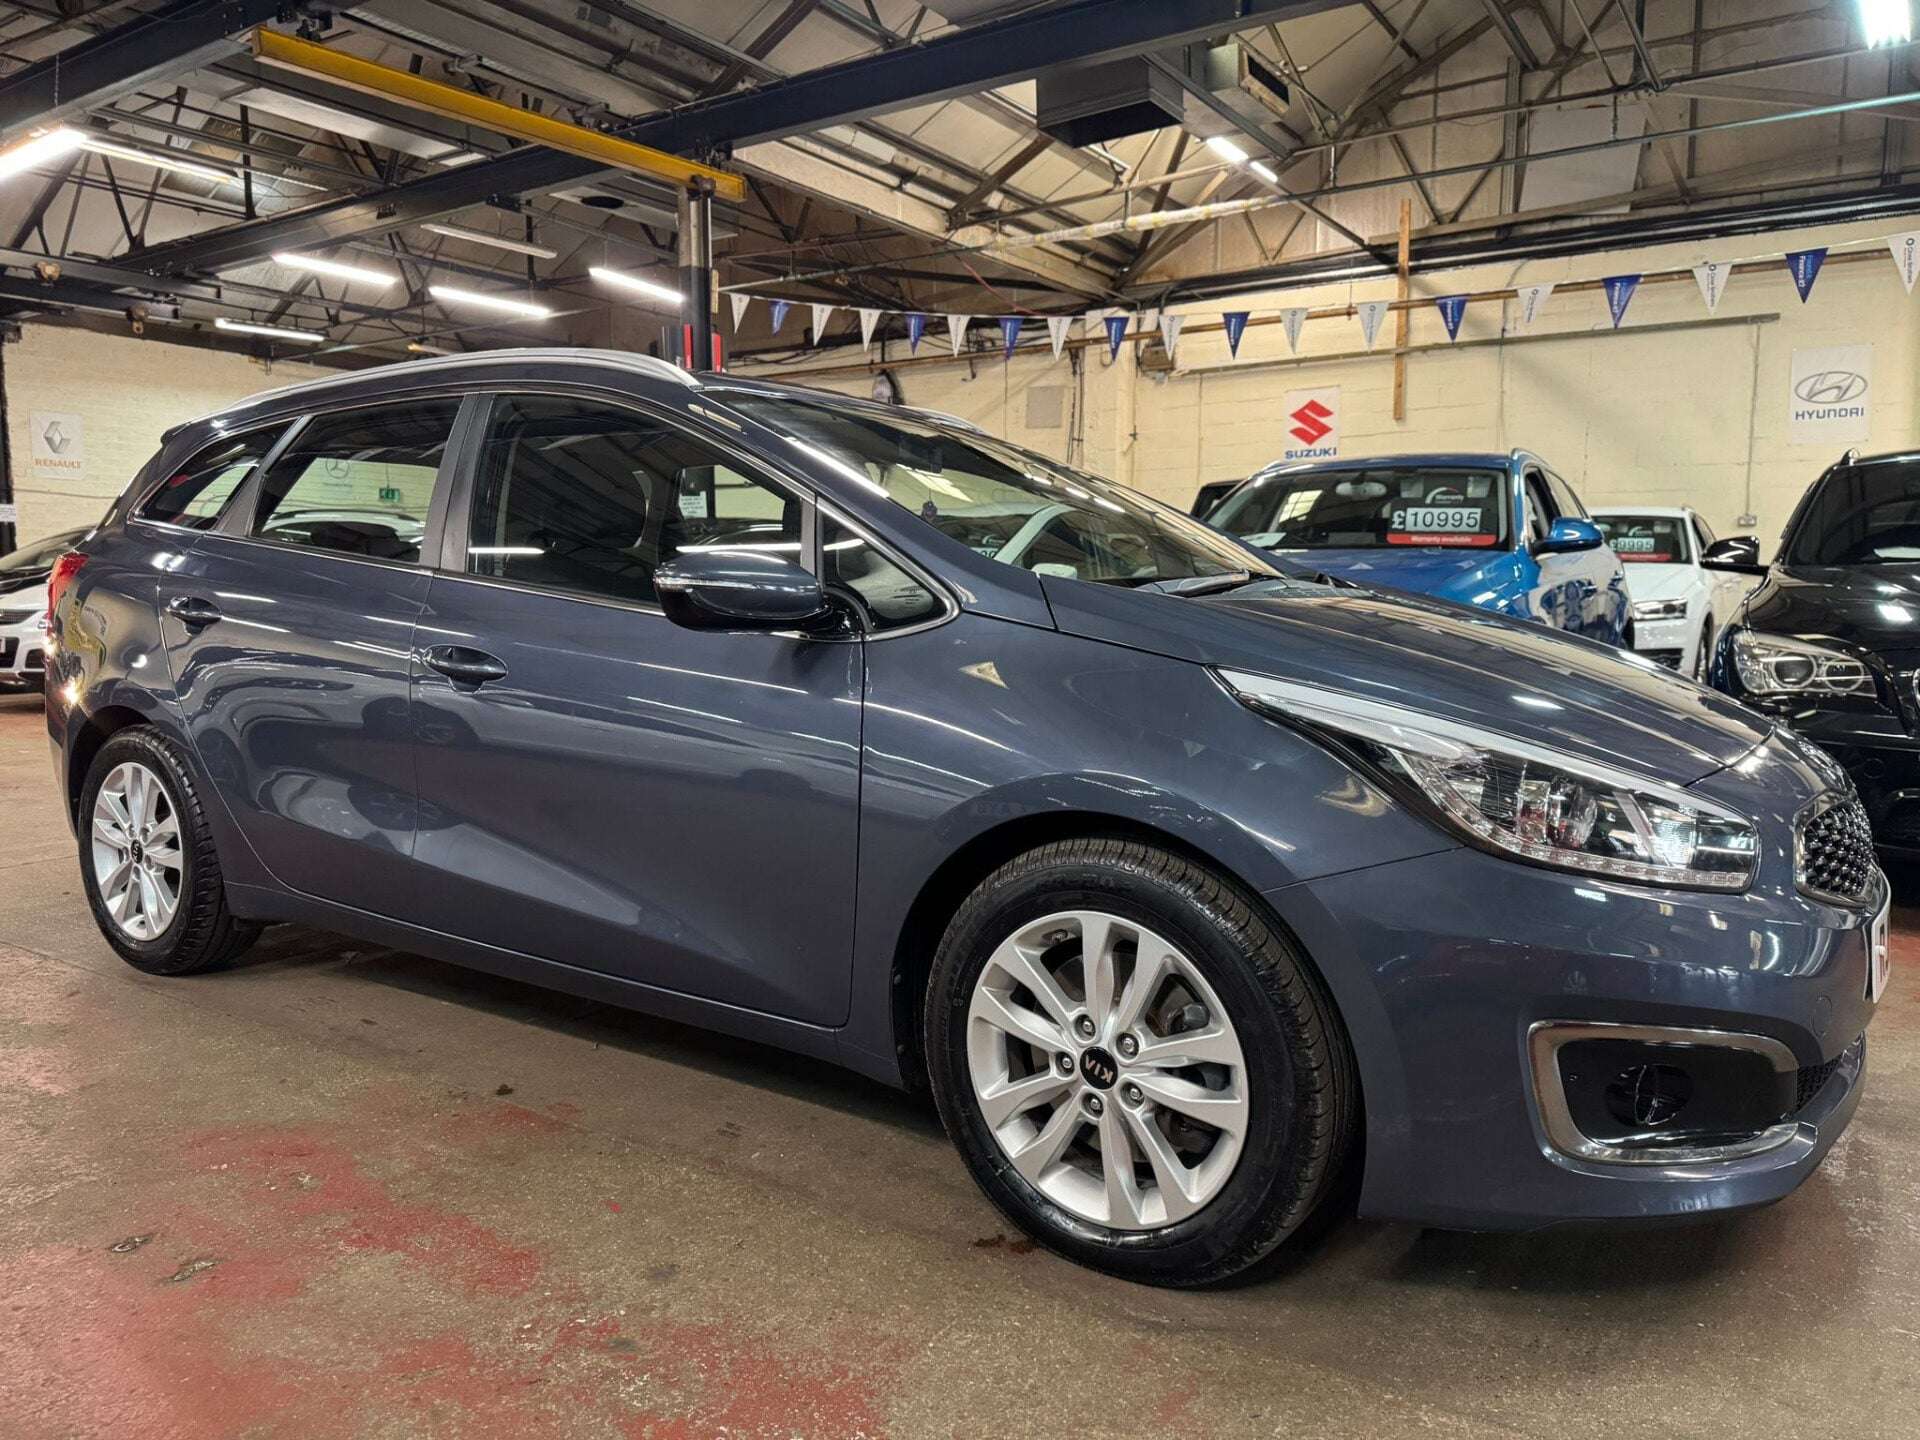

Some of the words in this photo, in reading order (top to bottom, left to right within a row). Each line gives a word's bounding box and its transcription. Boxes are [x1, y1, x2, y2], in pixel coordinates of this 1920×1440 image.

[1795, 407, 1864, 420] HYUNDAI
[1285, 447, 1337, 459] SUZUKI
[33, 459, 81, 469] RENAULT
[1085, 1055, 1114, 1084] KIA
